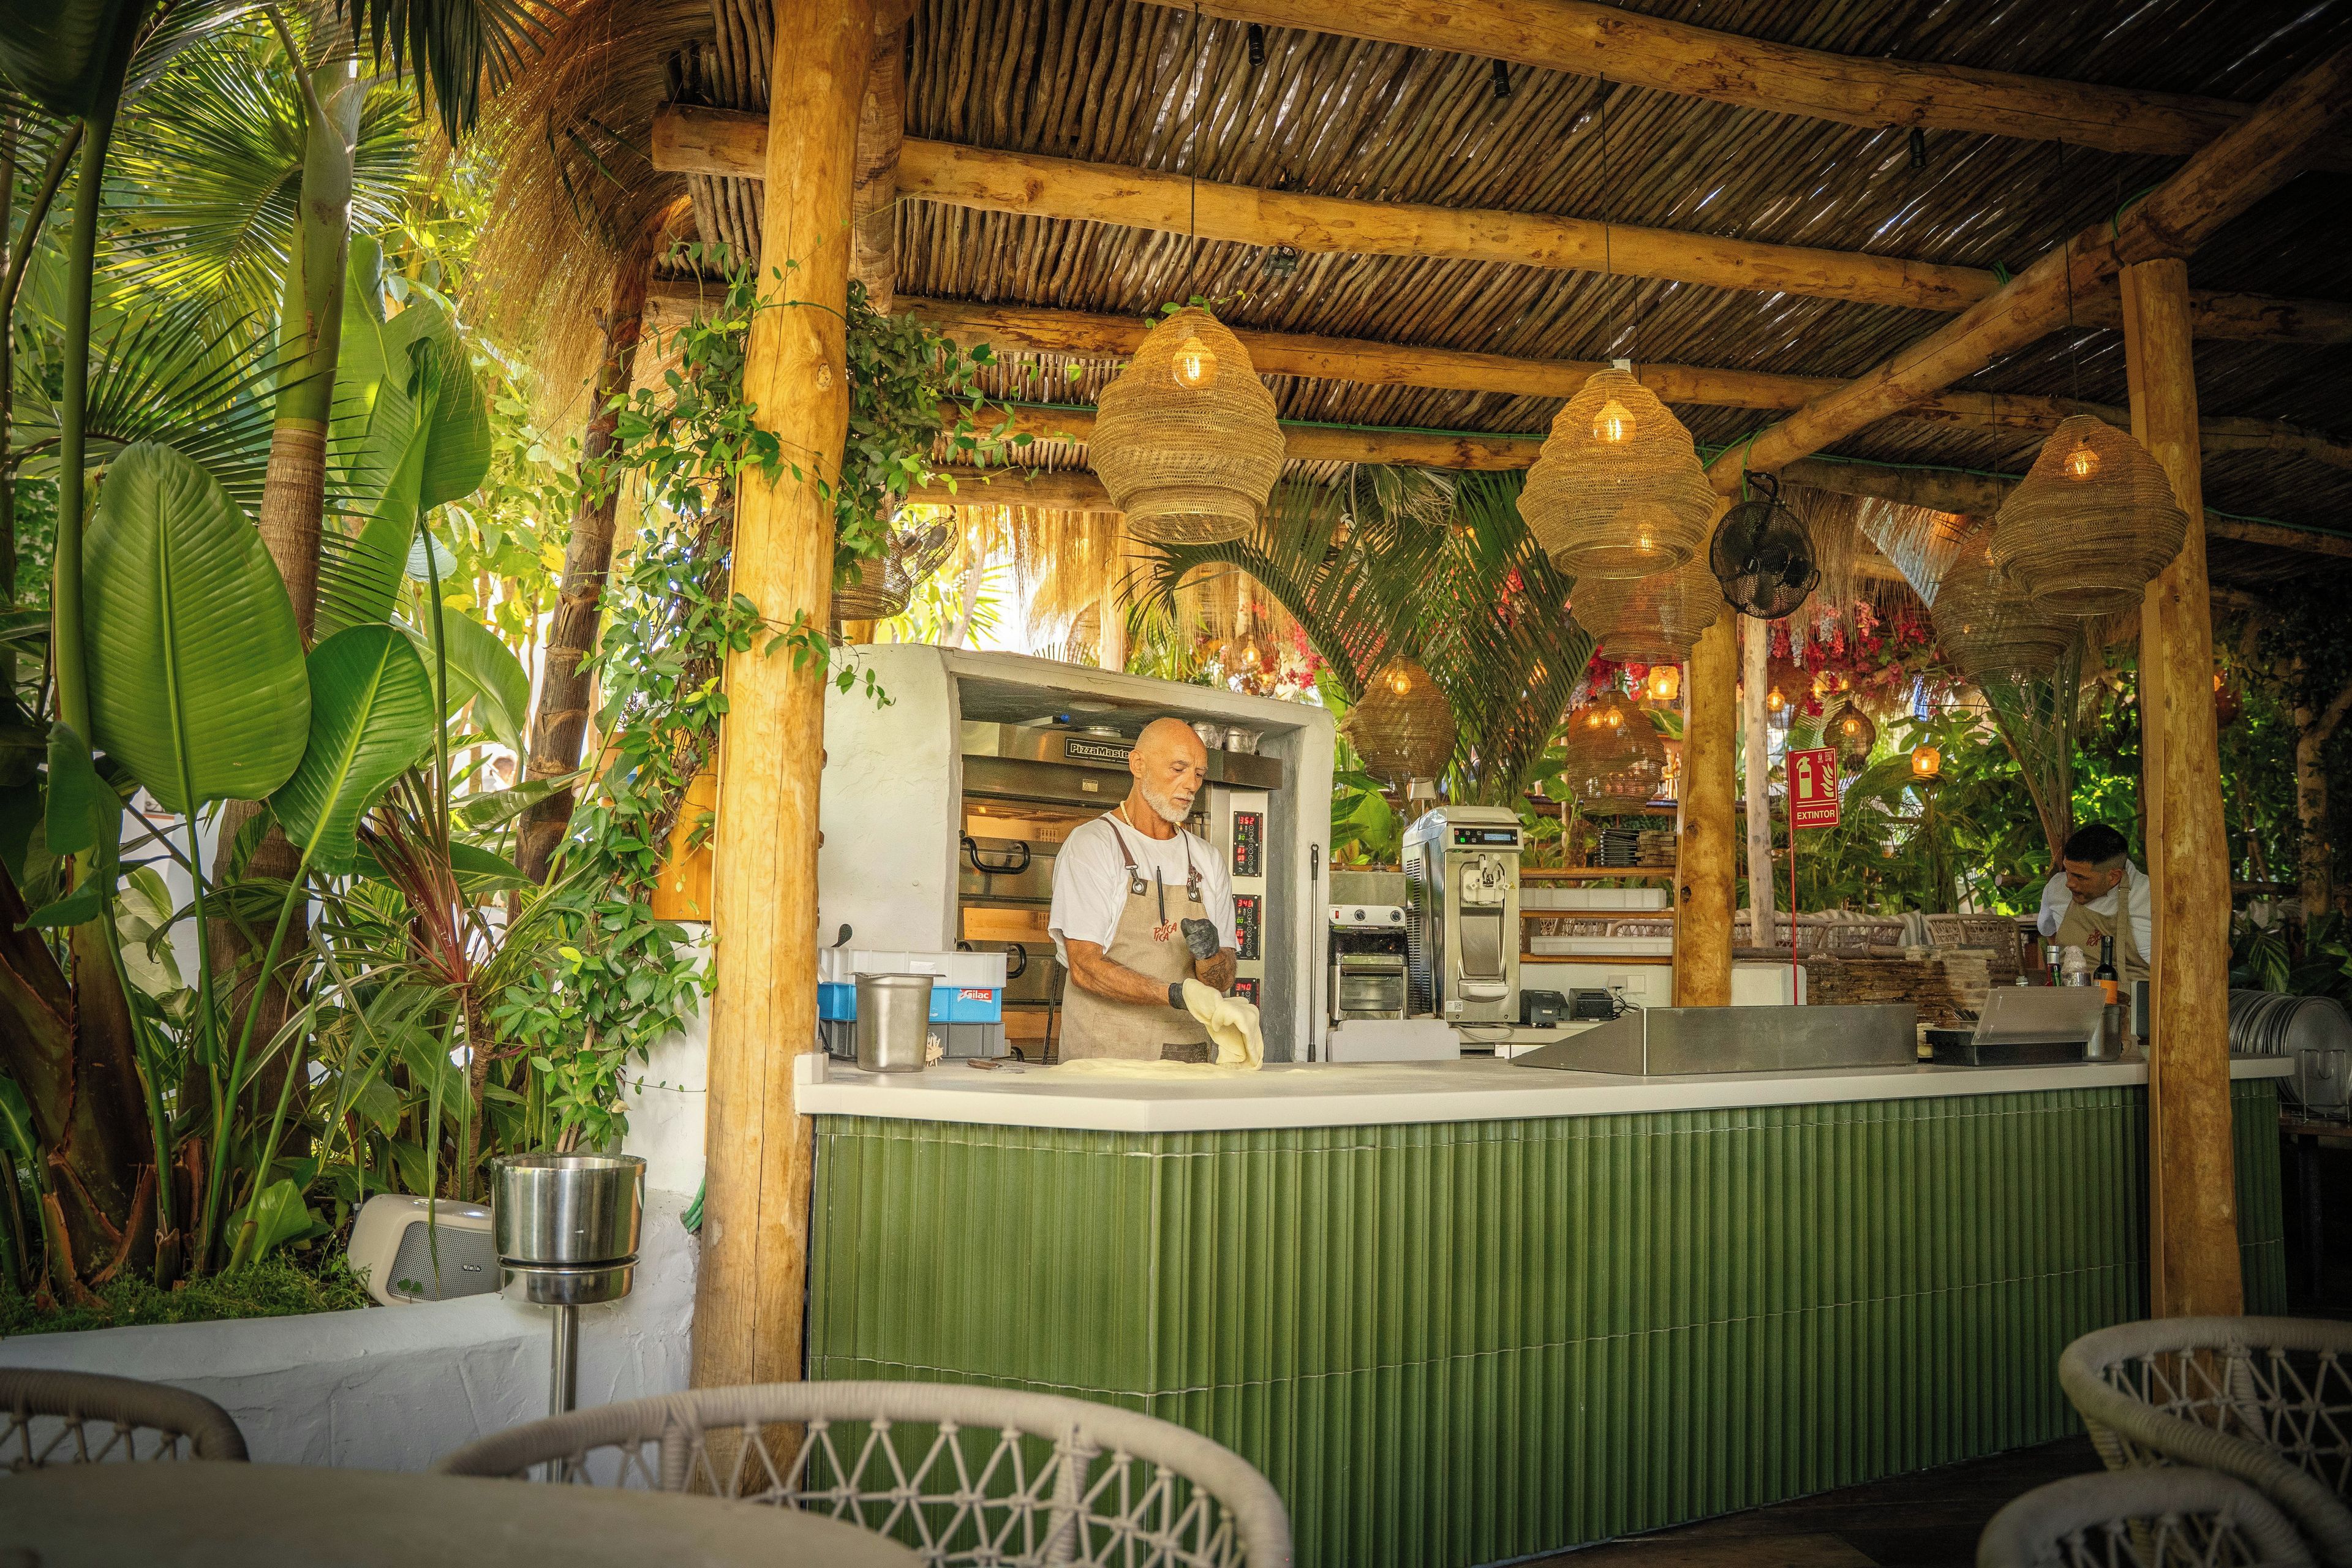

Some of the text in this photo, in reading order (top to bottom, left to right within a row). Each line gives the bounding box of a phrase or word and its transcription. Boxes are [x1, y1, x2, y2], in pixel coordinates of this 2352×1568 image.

[1071, 743, 1129, 759] PizzaMaste
[1796, 810, 1835, 820] EXTINTOR
[963, 990, 989, 999] Gilac
